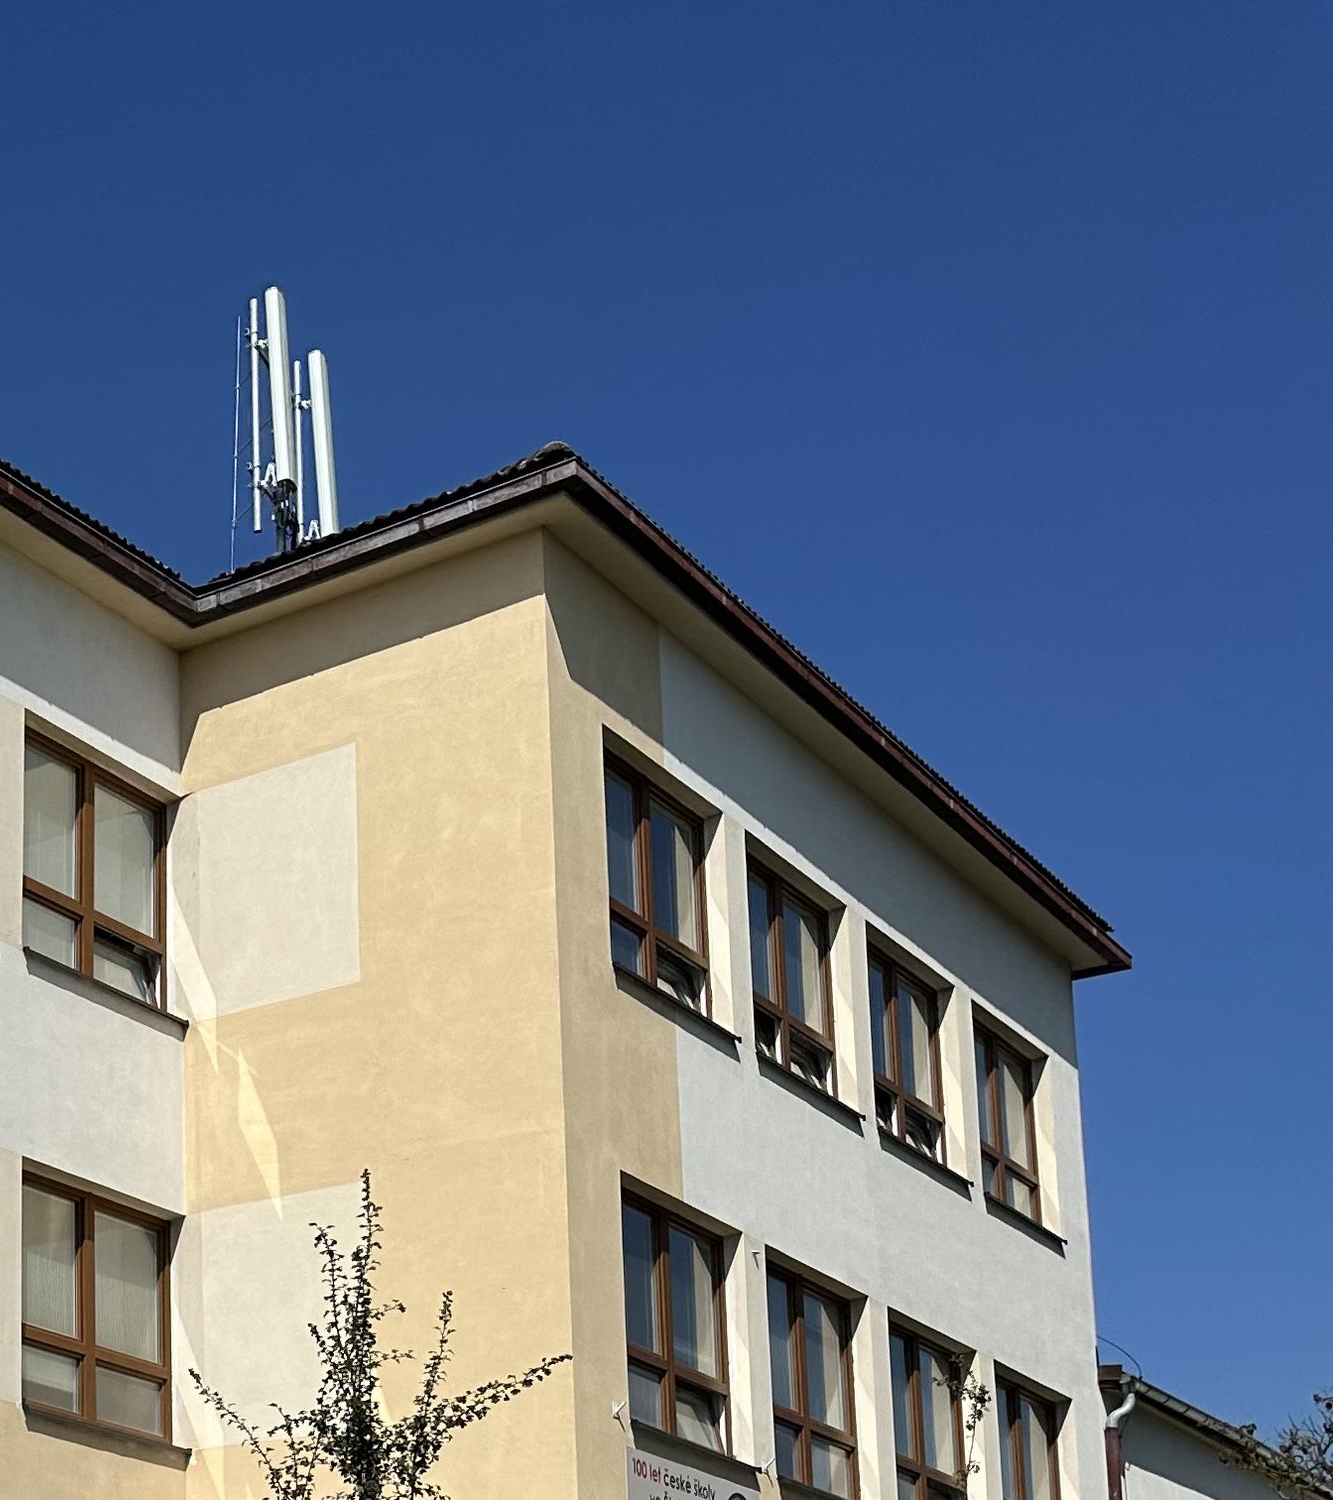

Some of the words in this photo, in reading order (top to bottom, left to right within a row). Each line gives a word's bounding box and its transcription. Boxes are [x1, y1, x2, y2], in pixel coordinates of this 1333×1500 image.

[632, 1458, 647, 1479] 100
[649, 1465, 661, 1483] let
[663, 1468, 691, 1494] české
